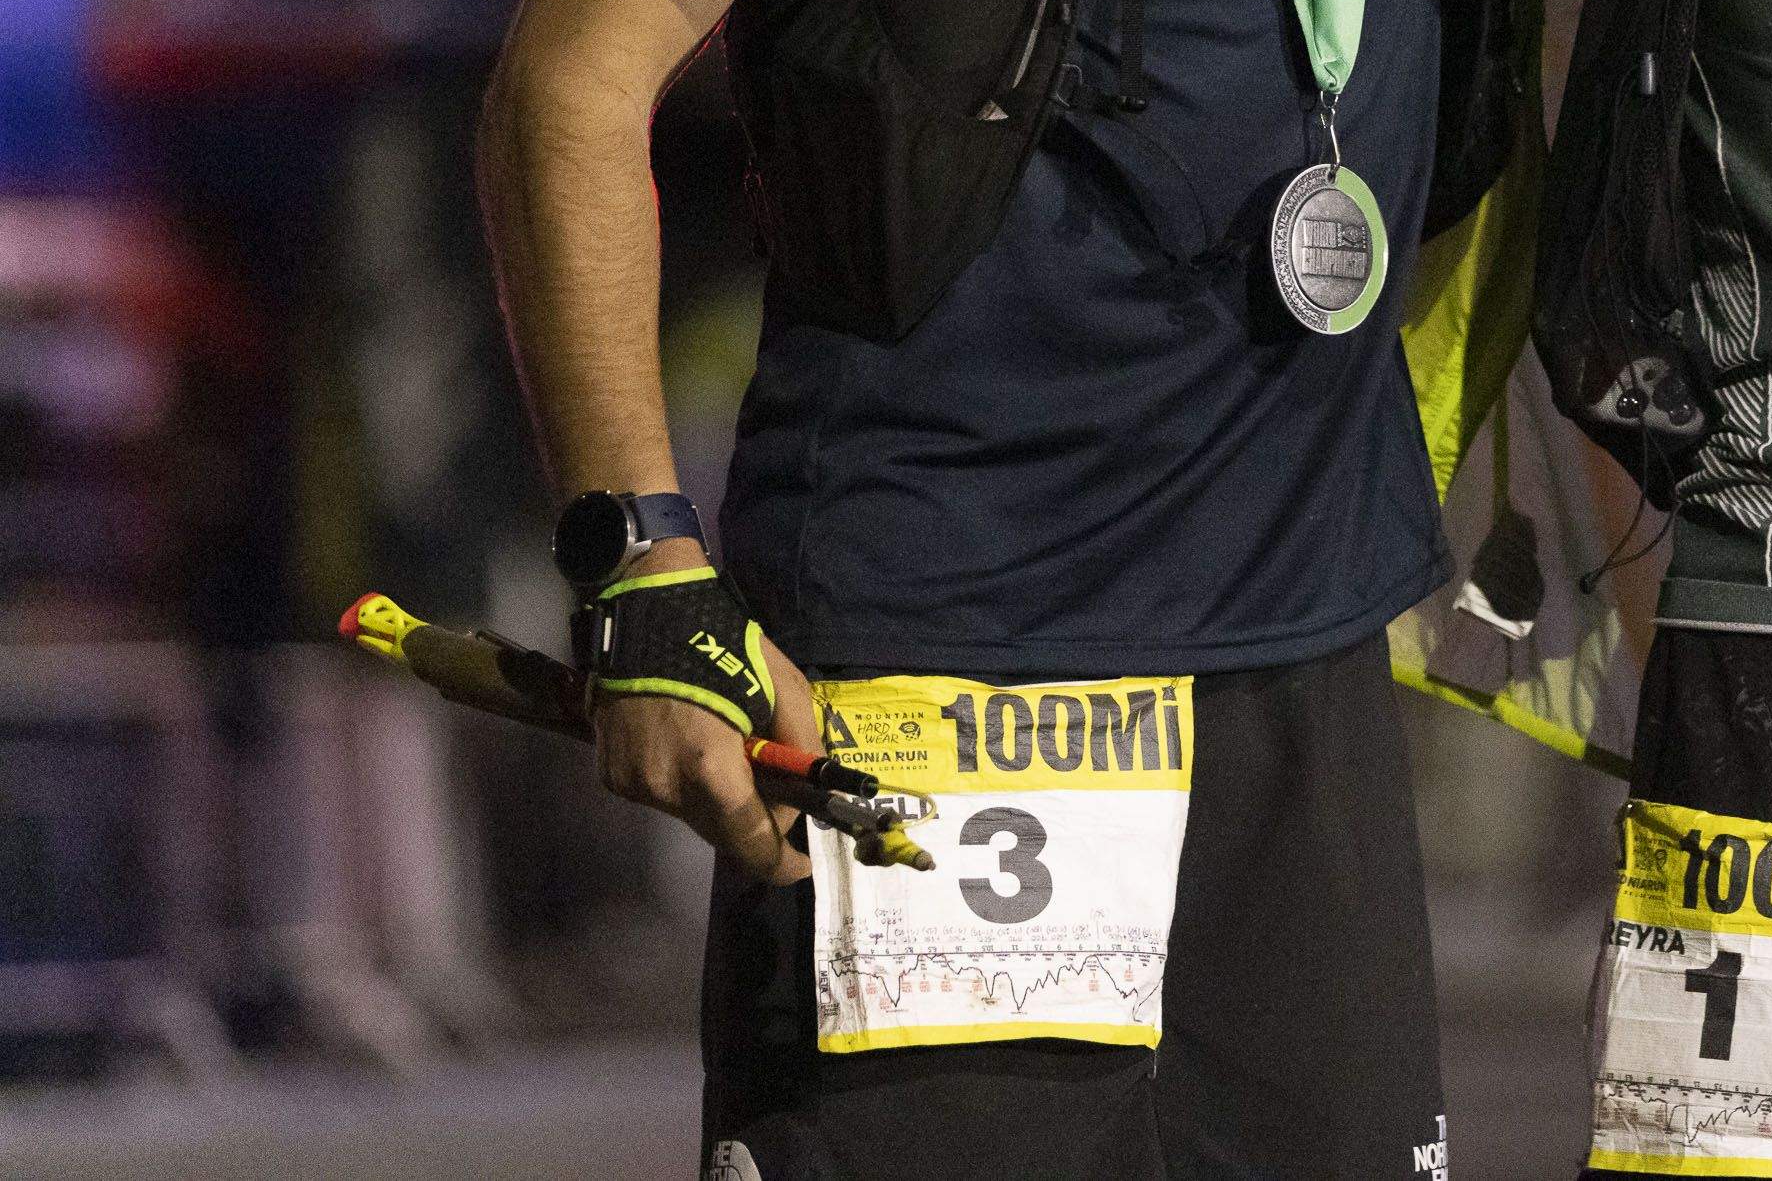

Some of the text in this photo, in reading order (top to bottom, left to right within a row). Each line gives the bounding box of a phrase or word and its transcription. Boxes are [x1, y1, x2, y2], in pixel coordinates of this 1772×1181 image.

[688, 630, 761, 697] LEKI
[855, 711, 925, 721] MOUNTAIN
[857, 722, 891, 735] HARD
[941, 688, 1184, 774] 100Mi
[865, 734, 899, 744] WEAR
[895, 750, 928, 763] RUN
[959, 806, 1053, 925] 3
[1685, 950, 1742, 1061] 1
